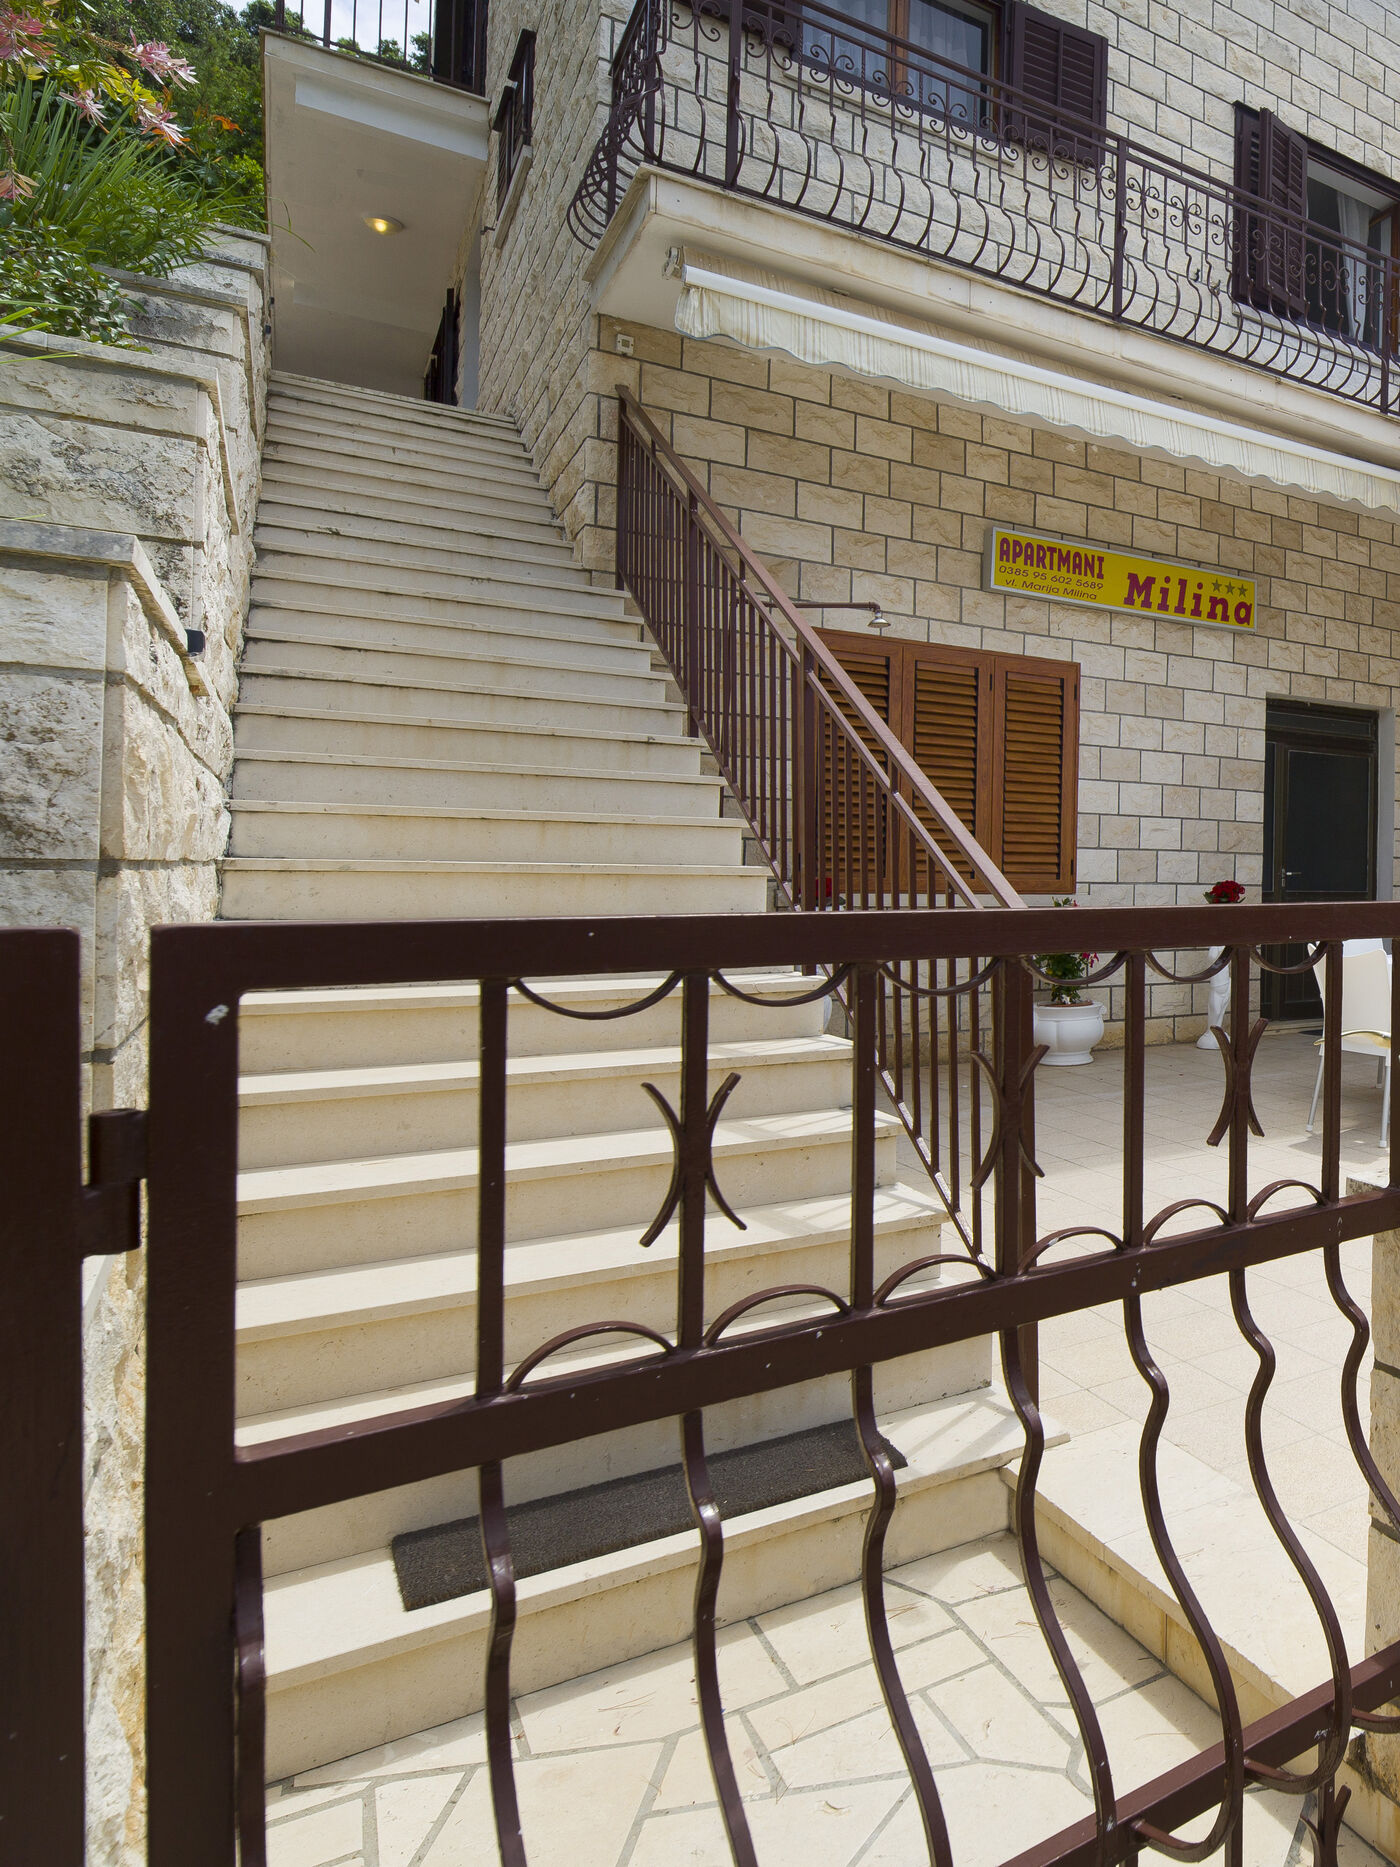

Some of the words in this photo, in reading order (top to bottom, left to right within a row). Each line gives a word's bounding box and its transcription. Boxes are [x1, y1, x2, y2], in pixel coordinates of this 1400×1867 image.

[1000, 537, 1104, 579] APARTMANI
[999, 565, 1029, 577] 0385
[1033, 571, 1047, 581] 95
[1051, 576, 1072, 585] 602
[1076, 579, 1104, 590] 5689
[1005, 578, 1017, 587] vl.
[1022, 581, 1059, 594] Marija
[1063, 587, 1097, 600] Milina
[1124, 572, 1252, 626] Milina
